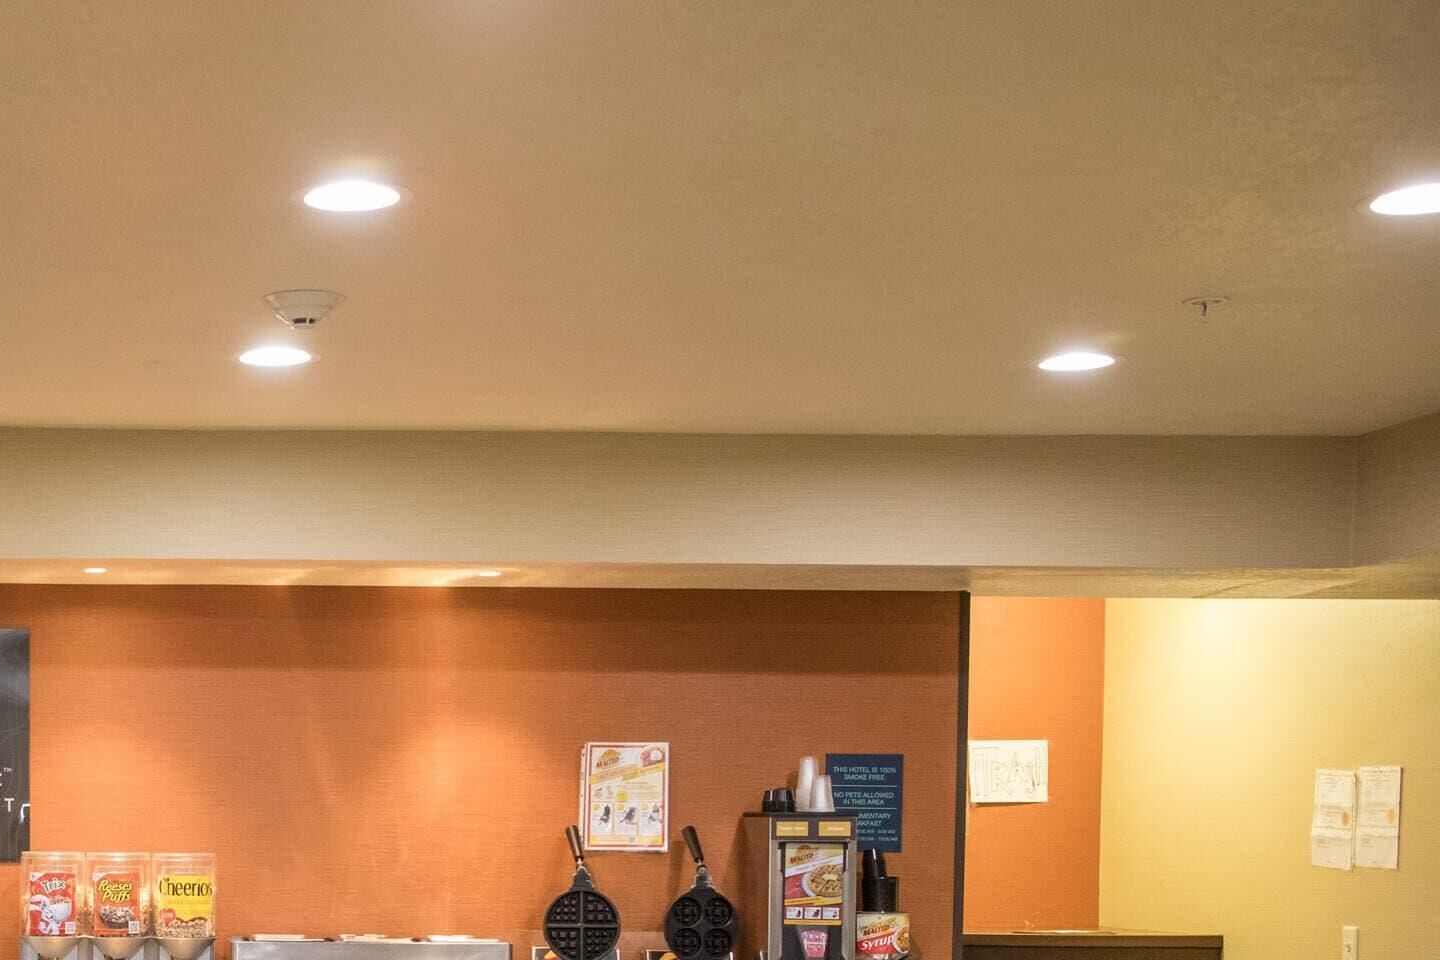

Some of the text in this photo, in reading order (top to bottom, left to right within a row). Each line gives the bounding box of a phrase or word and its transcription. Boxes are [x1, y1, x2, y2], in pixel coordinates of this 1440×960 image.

[40, 878, 65, 893] Trix
[159, 878, 213, 897] Cheerios
[102, 890, 130, 903] Puffs
[861, 934, 895, 951] Syrup
